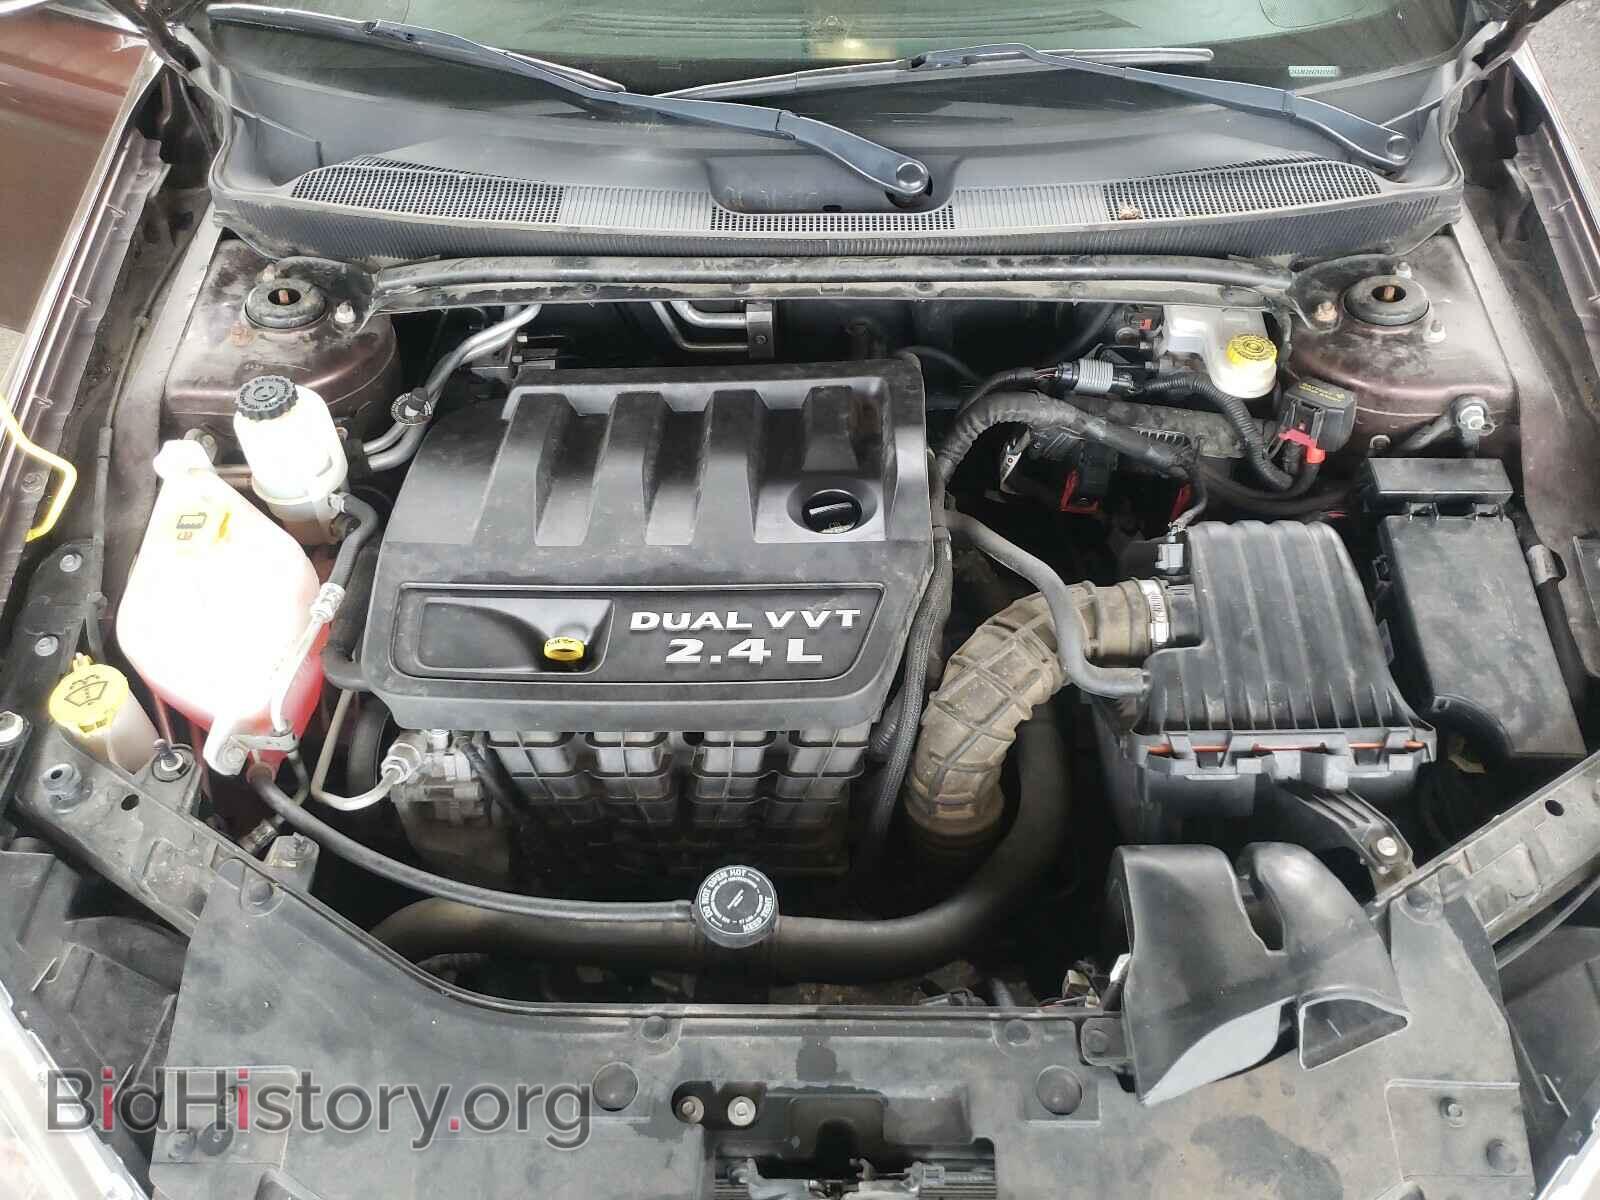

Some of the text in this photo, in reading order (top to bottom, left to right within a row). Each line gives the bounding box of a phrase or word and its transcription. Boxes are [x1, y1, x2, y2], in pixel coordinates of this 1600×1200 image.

[629, 609, 861, 631] DUAL VVT
[701, 869, 747, 918] DO NOT OPEN HOT
